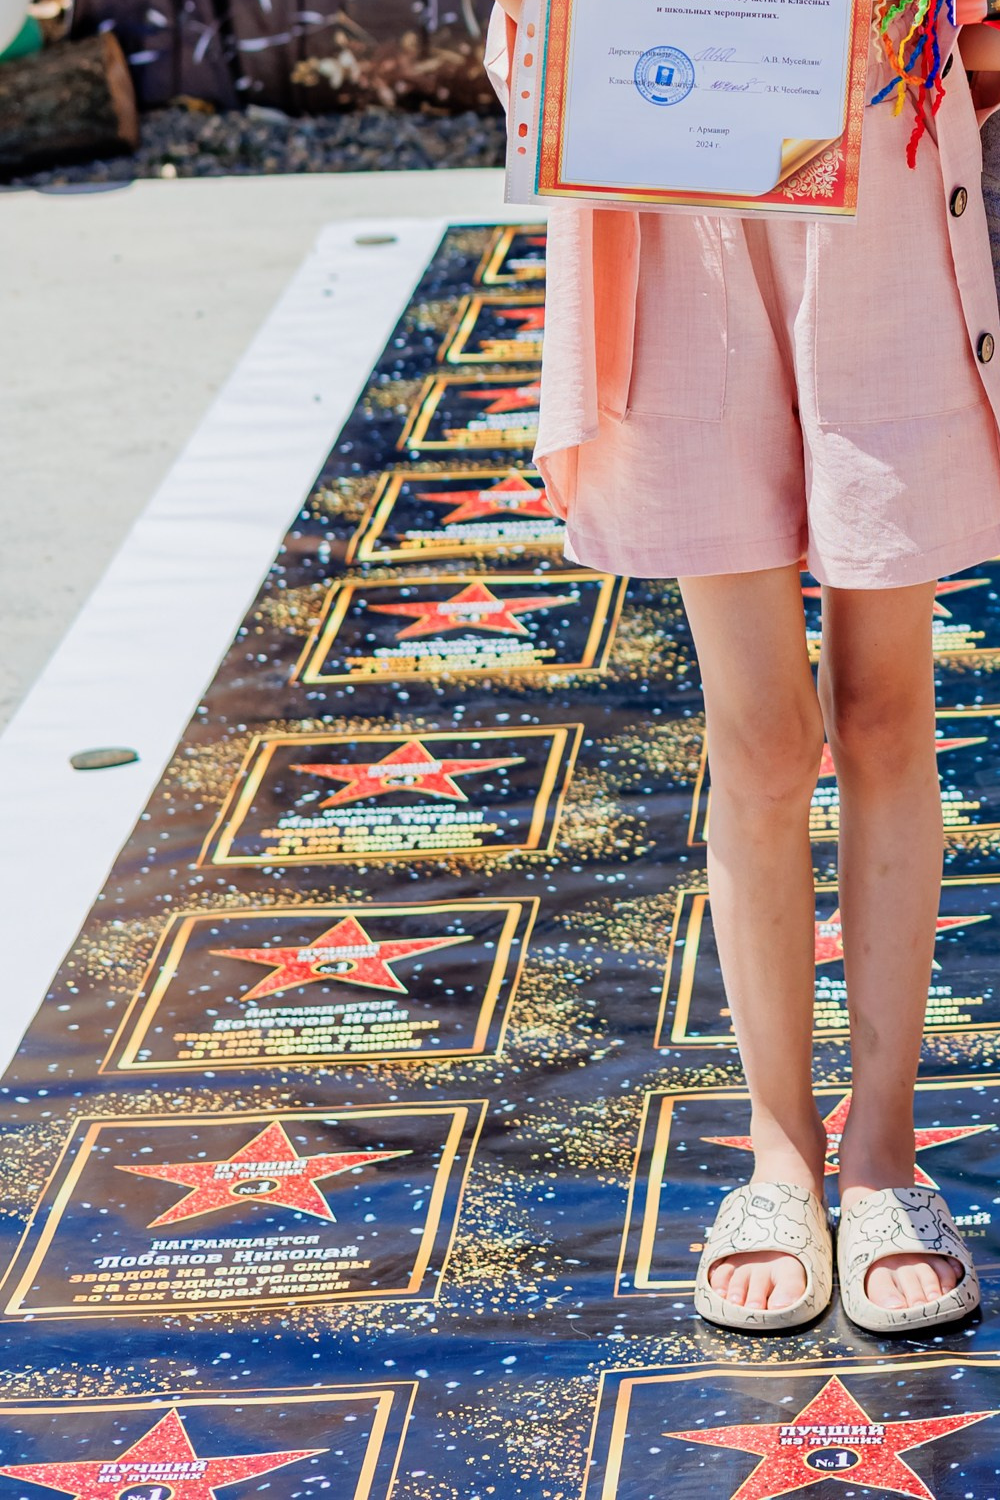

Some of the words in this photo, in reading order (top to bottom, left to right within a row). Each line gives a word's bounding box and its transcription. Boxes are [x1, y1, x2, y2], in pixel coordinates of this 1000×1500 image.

[664, 7, 711, 15] школьных
[714, 9, 780, 19] мероприятиях.
[608, 47, 643, 56] Директор
[697, 126, 730, 135] Армавир
[696, 140, 713, 148] 2024
[151, 1235, 321, 1250] НАГРАЖДАЕТСЯ
[98, 1252, 224, 1269] Лобанов
[232, 1245, 360, 1263] Николай
[68, 1268, 170, 1283] звездой
[176, 1268, 207, 1278] на
[213, 1264, 286, 1276] аллее
[293, 1260, 371, 1272] славы
[91, 1284, 121, 1293] за
[127, 1277, 249, 1292] звездные
[255, 1271, 341, 1287] успехи
[72, 1294, 103, 1303] во
[108, 1292, 167, 1302] всех
[172, 1286, 264, 1301] сферах
[268, 1281, 351, 1294] жизни
[779, 1424, 886, 1437] ЛУЧШИЙ
[780, 1436, 804, 1446] из
[809, 1436, 883, 1447] лучших
[99, 1459, 208, 1474] ЛУЧШИЙ
[97, 1474, 123, 1483] из
[126, 1472, 201, 1483] лучших
